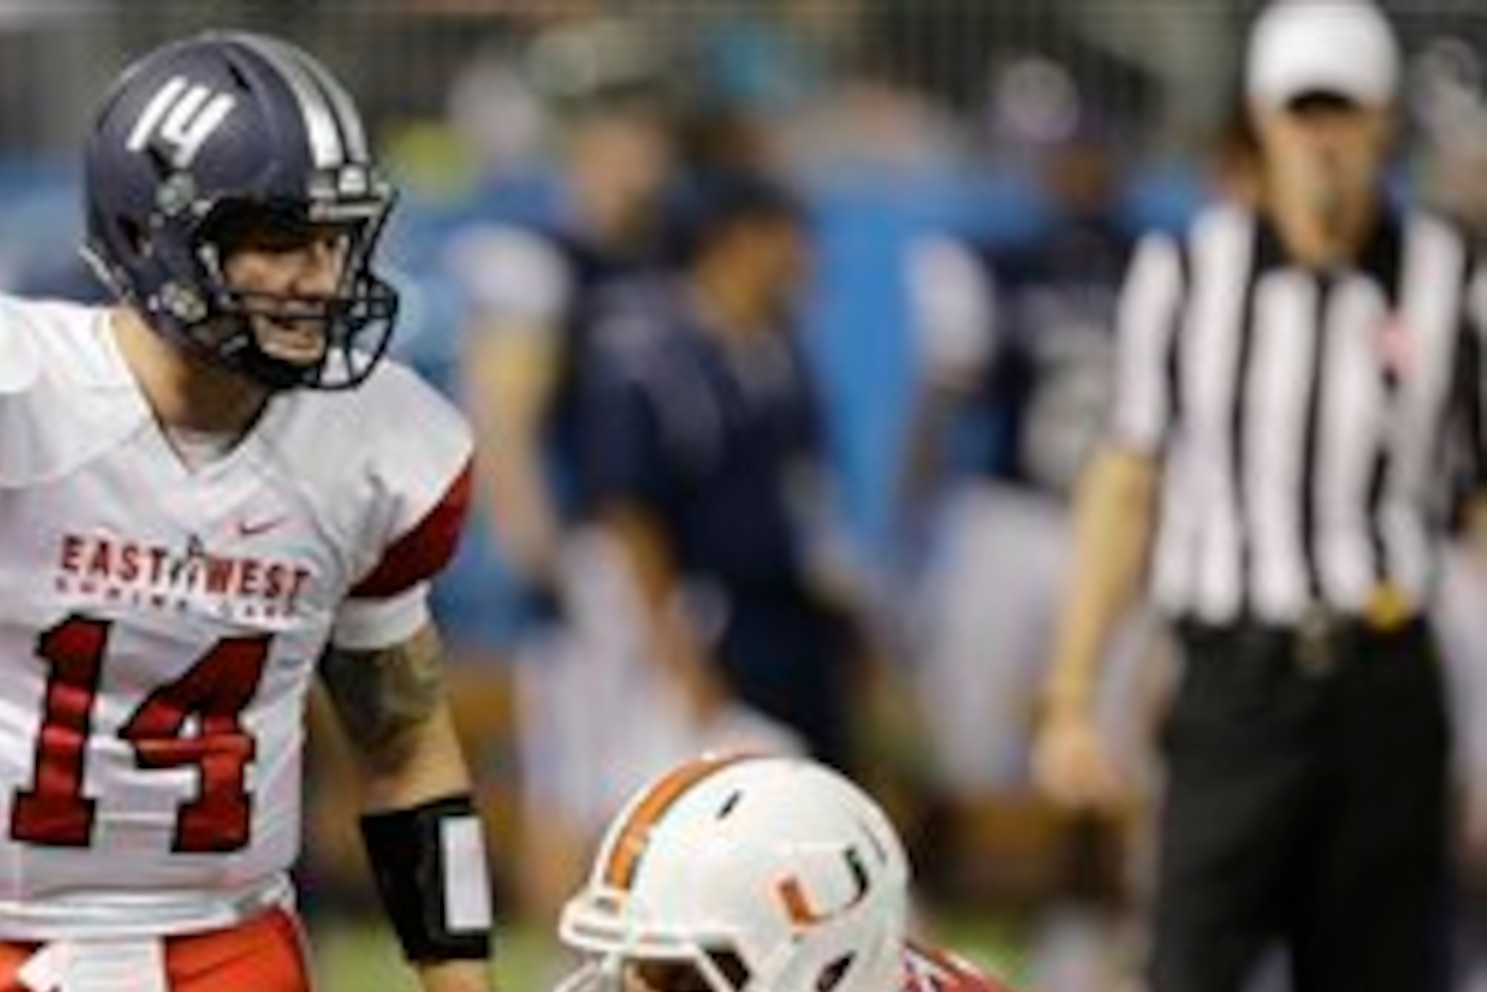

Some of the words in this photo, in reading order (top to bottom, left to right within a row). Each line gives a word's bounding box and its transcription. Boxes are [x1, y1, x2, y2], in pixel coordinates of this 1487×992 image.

[125, 75, 237, 169] 14
[60, 533, 169, 585] EAST
[204, 553, 311, 602] WEST
[9, 612, 275, 854] 14
[775, 845, 870, 926] U
